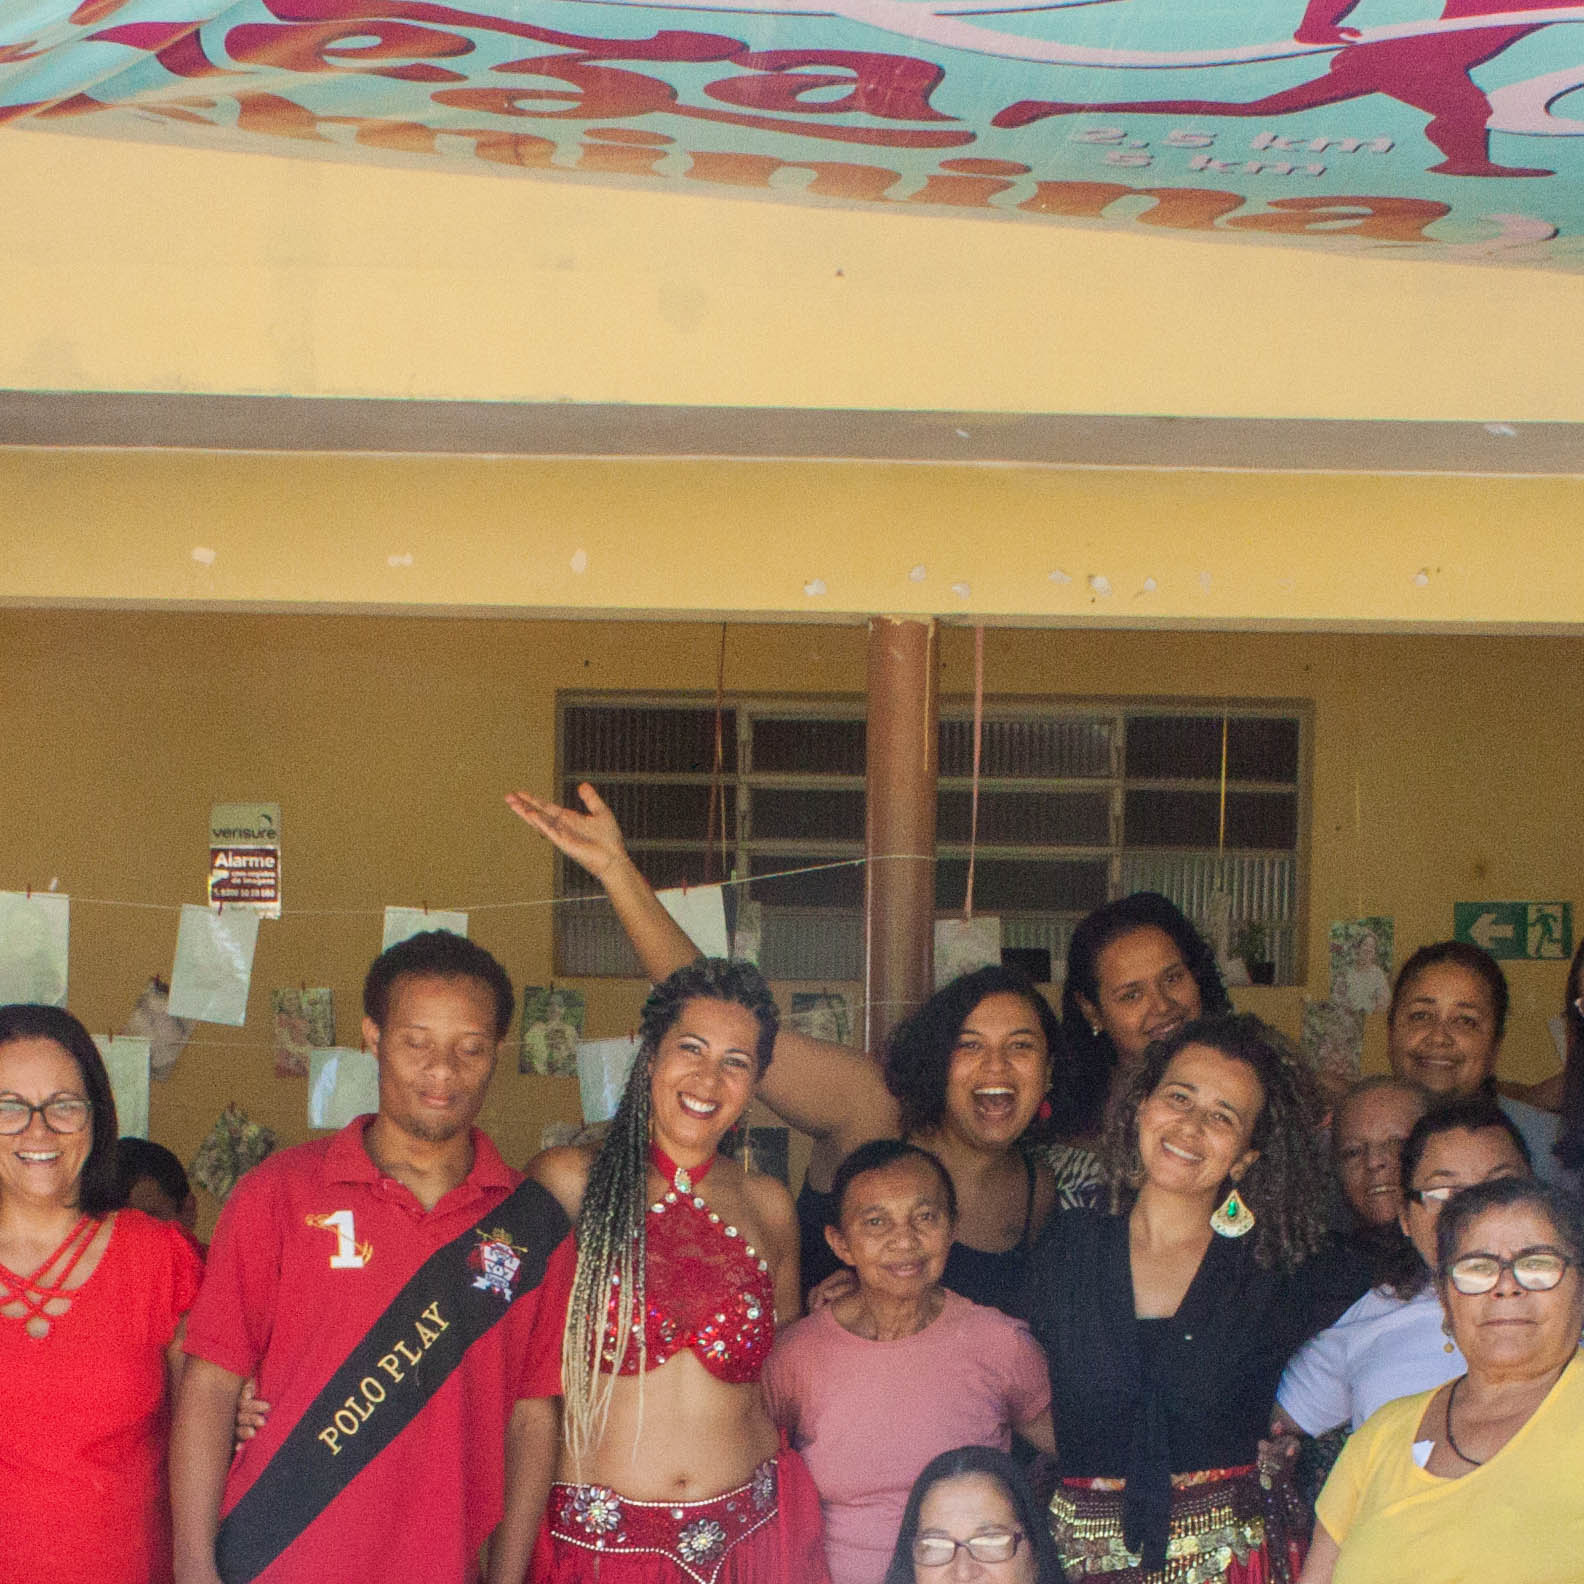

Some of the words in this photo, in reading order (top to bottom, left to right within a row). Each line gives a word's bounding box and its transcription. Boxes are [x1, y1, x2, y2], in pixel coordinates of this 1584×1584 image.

[214, 851, 277, 868] Alarme
[325, 1210, 365, 1269] 1
[318, 1376, 387, 1456] POLO
[377, 1301, 450, 1383] PLAY
